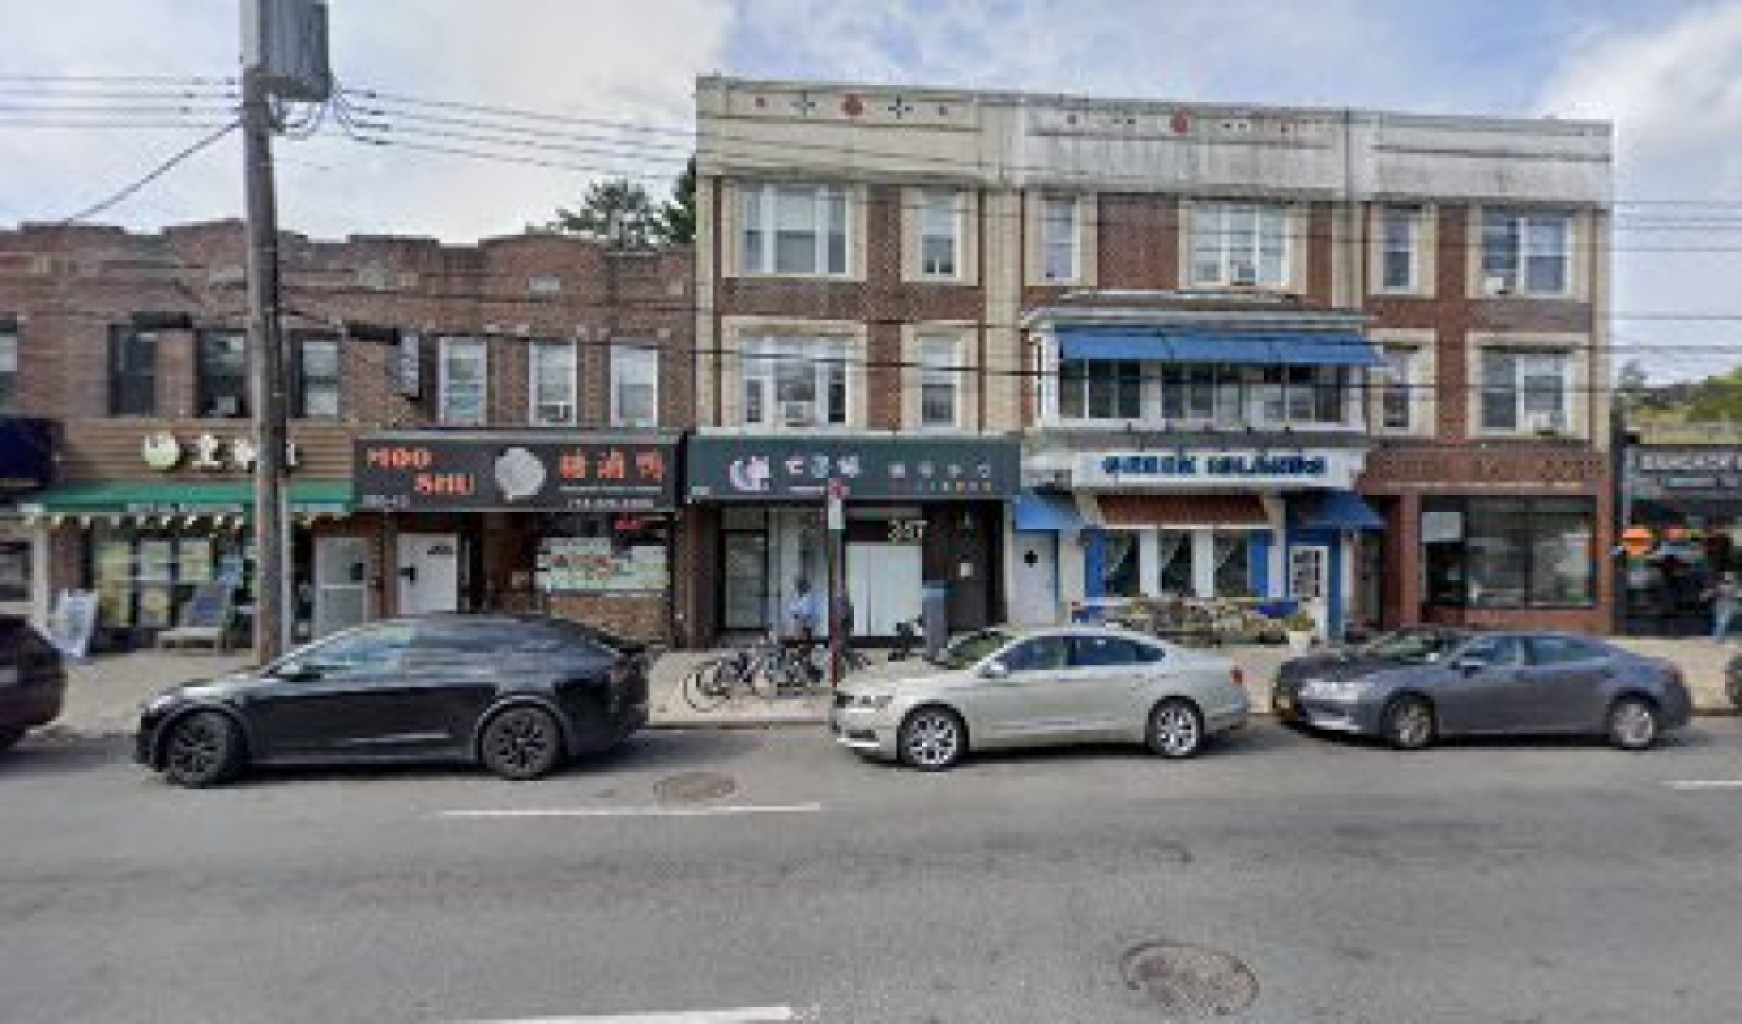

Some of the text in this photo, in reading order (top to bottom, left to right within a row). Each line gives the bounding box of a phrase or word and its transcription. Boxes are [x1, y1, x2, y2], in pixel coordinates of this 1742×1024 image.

[367, 447, 432, 470] MOO
[1103, 455, 1328, 475] GREEK ISLANDS
[413, 472, 474, 496] SHU
